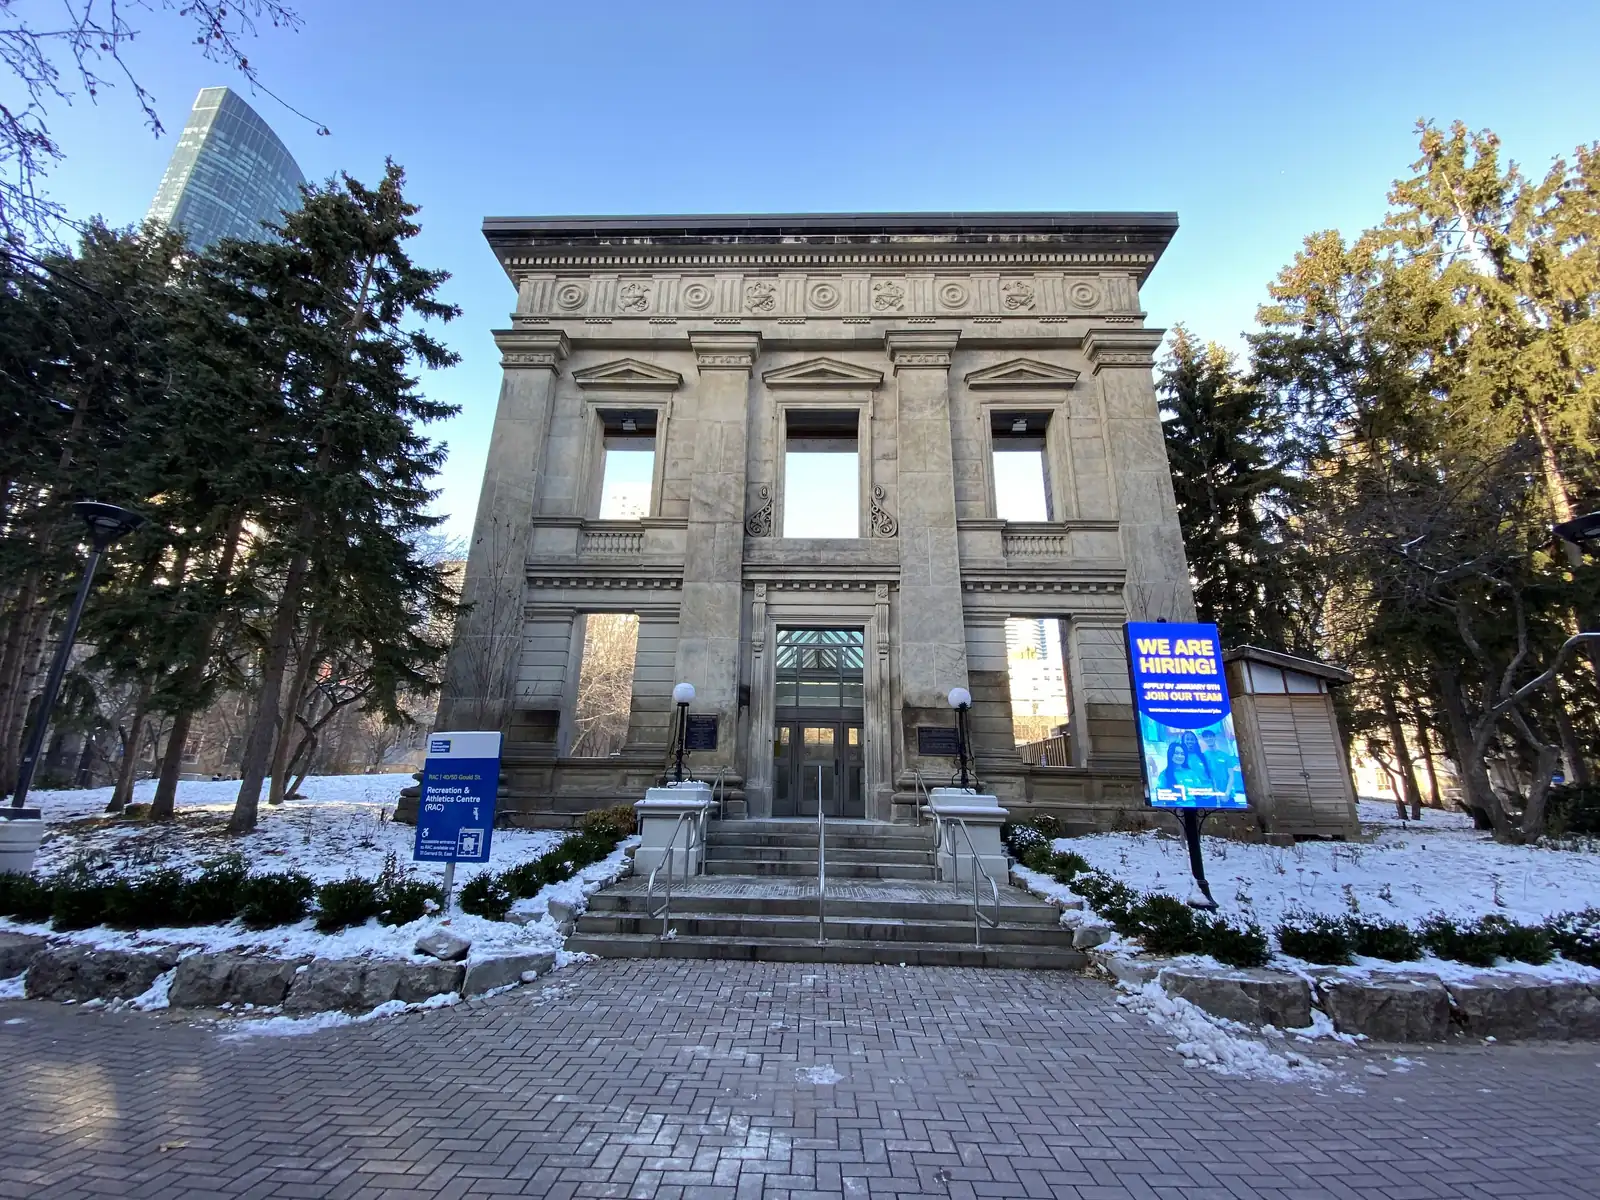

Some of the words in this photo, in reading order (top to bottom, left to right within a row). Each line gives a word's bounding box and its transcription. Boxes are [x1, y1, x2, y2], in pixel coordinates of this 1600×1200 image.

[1137, 638, 1171, 655] WE
[1175, 639, 1214, 656] ARE
[1140, 657, 1217, 675] HIRING!
[1143, 682, 1164, 690] APPLY
[1144, 691, 1168, 700] JOIN
[1170, 692, 1192, 701] OUR
[1193, 692, 1222, 702] TEAM
[427, 786, 462, 794] Recreation
[464, 786, 470, 794] &
[425, 795, 454, 803] Athletics
[456, 795, 481, 803] Centre
[424, 803, 444, 812] (RAC)
